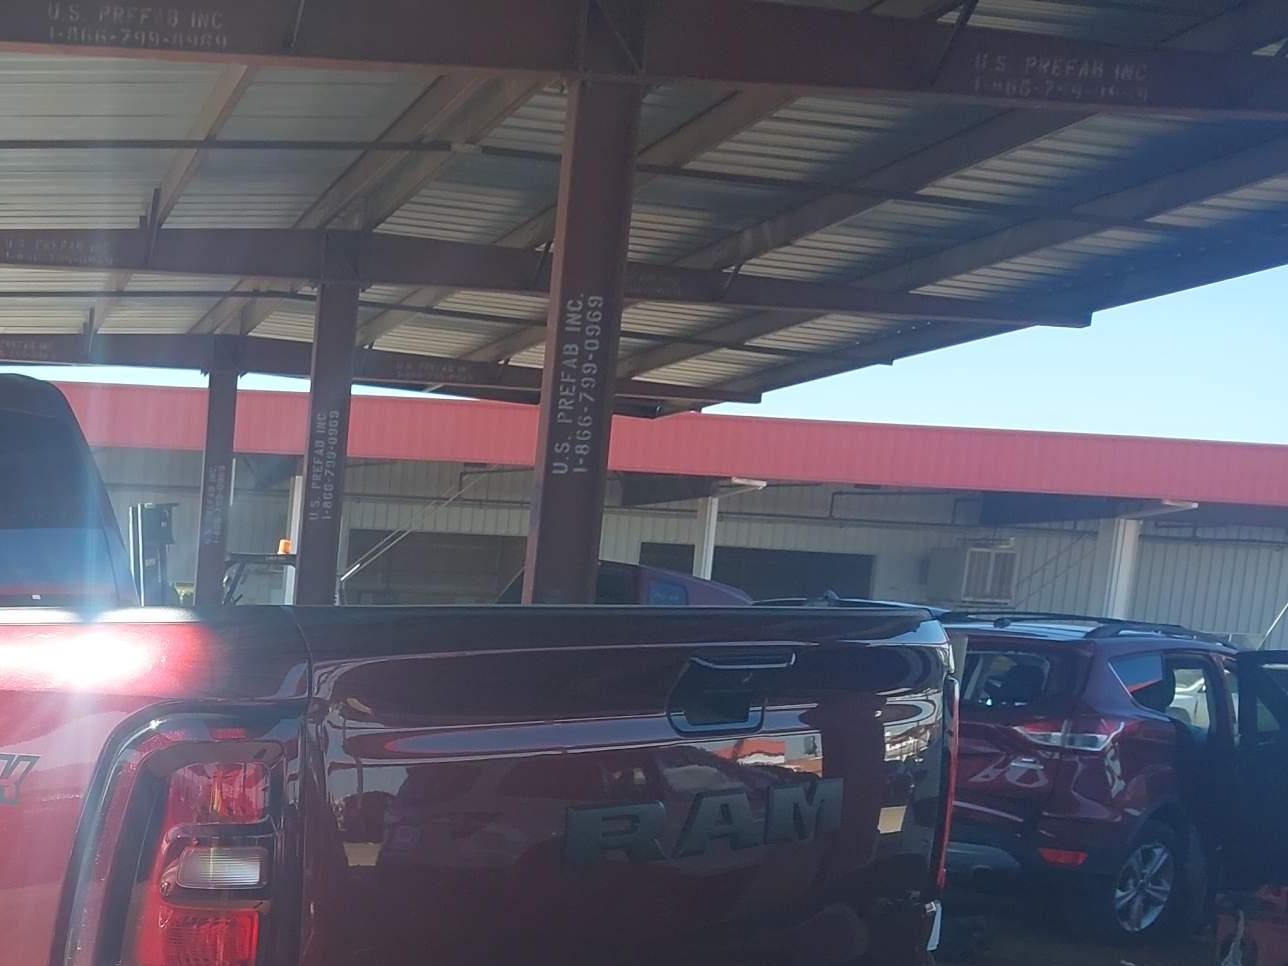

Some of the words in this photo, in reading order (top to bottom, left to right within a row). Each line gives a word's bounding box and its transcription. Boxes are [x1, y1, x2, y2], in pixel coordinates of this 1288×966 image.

[565, 293, 584, 332] INC.
[557, 343, 579, 423] PREFAB
[573, 295, 603, 473] 1-866-799-0969
[552, 436, 570, 474] U.S.
[566, 778, 843, 862] RAM
